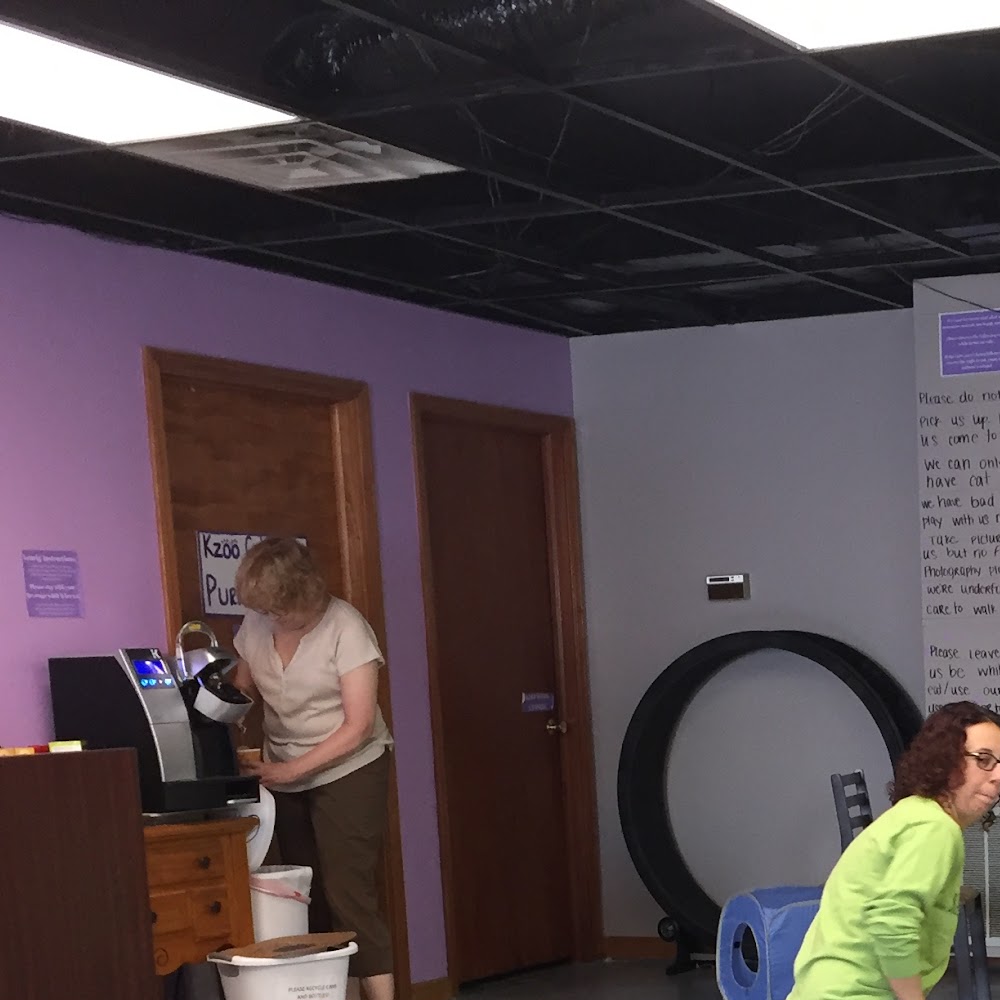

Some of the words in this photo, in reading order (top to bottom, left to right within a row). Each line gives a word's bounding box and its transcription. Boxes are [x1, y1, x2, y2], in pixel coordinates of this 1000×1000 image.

[919, 392, 953, 404] Please
[960, 391, 973, 403] do
[951, 416, 964, 426] us
[920, 434, 938, 447] us
[948, 433, 978, 446] come
[987, 429, 996, 442] to
[948, 458, 970, 470] can
[926, 476, 956, 488] have
[970, 470, 990, 487] cat
[922, 500, 934, 509] we
[937, 495, 962, 508] have
[971, 493, 994, 508] bad
[922, 515, 942, 529] play
[952, 514, 974, 526] with
[978, 514, 990, 525] us
[923, 550, 937, 560] us
[946, 548, 966, 558] but
[974, 549, 987, 559] no
[206, 574, 240, 606] PUR
[954, 602, 963, 614] to
[973, 604, 996, 615] walk
[930, 644, 959, 659] Please
[930, 668, 942, 679] us
[949, 665, 965, 678] be
